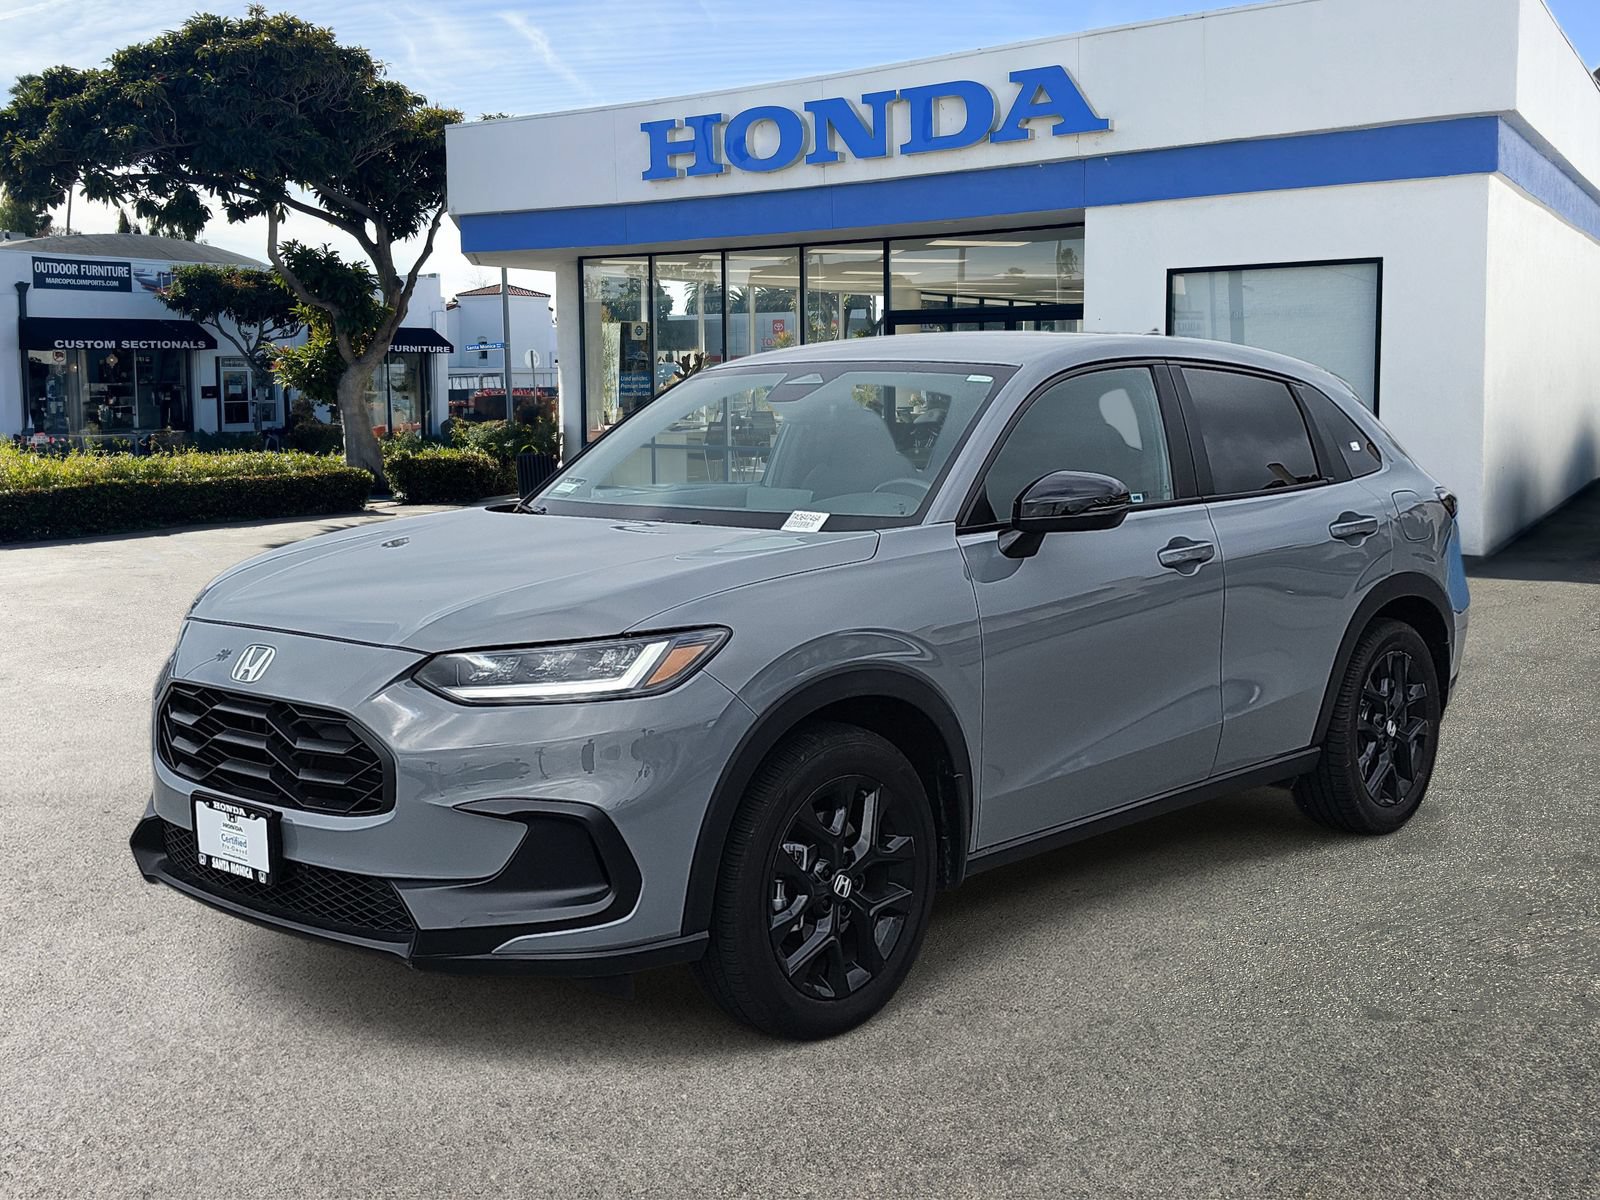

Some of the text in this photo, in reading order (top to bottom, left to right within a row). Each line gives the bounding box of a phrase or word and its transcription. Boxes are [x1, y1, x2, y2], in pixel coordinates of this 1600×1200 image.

[640, 65, 1114, 182] HONDA
[34, 261, 130, 278] OUTDOOR FURNITURE
[45, 277, 120, 287] MARCOPOLOIMPORTS.COM
[54, 339, 207, 350] CUSTOM SECTIONALS
[388, 344, 451, 353] FURNITURE
[212, 801, 247, 816] HONDA
[222, 822, 243, 832] HONDA
[221, 833, 247, 849] Certified
[212, 857, 230, 873] SANTA
[230, 862, 253, 880] MONICA
